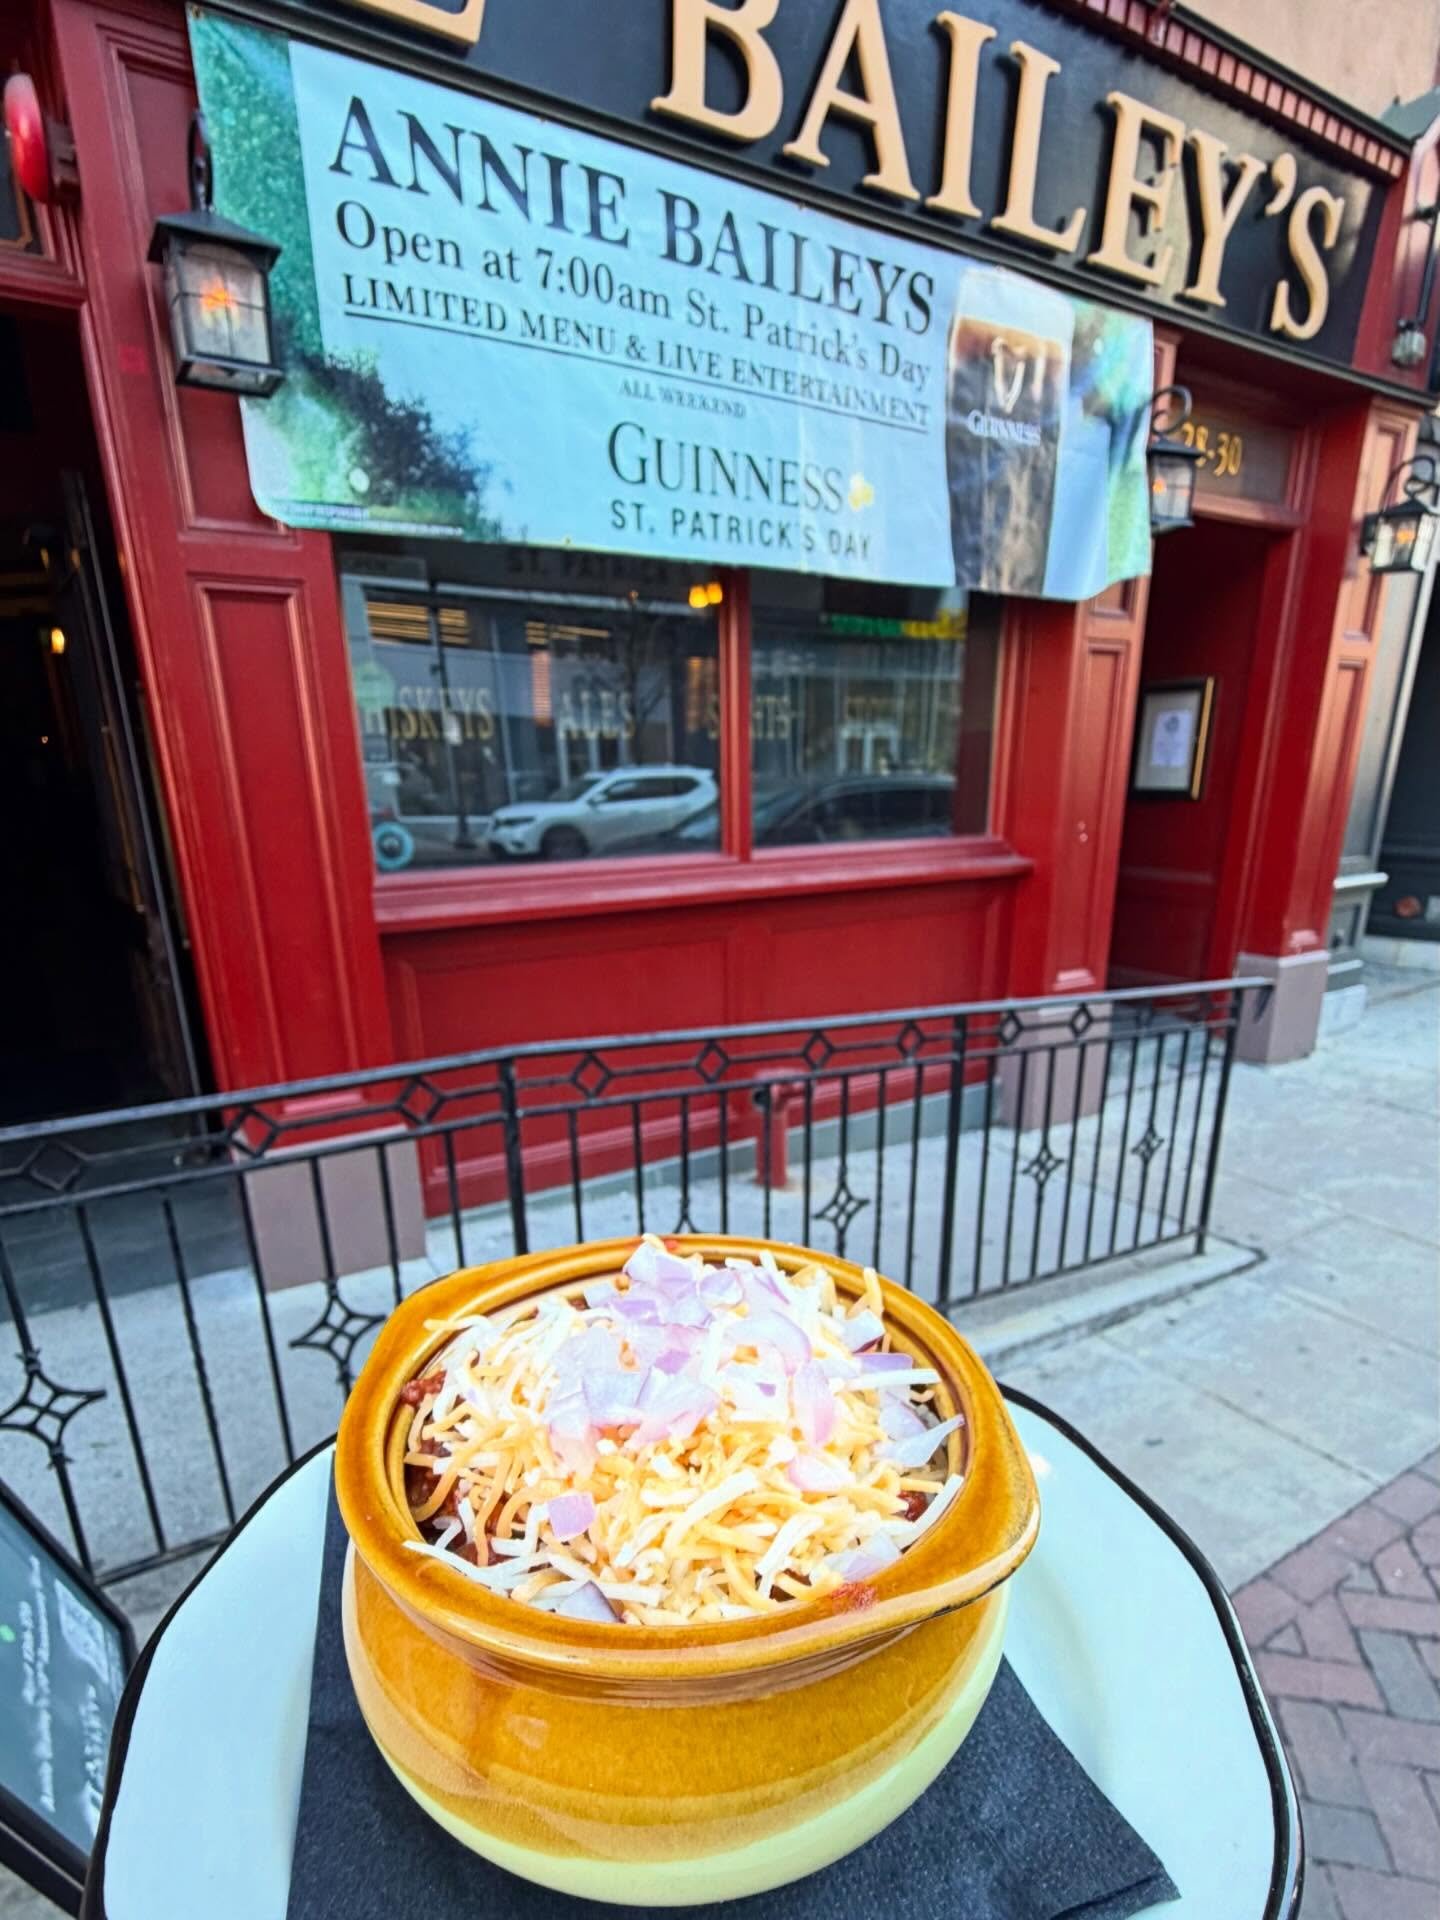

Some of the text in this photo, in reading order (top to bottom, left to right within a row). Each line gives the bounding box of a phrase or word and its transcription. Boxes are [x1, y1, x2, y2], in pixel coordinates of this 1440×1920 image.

[329, 95, 934, 335] ANNIE BAILEYS
[651, 0, 1345, 340] BAILEY'S
[336, 200, 931, 392] Open at 7:00am St. Patrick's Day
[343, 273, 932, 427] LIMITED MENU & LIVE ENTERTAINMENT
[608, 421, 844, 514] GUINNESS
[619, 377, 747, 419] ALL WEEKEND
[611, 499, 871, 559] ST. PATRICK'S DAY
